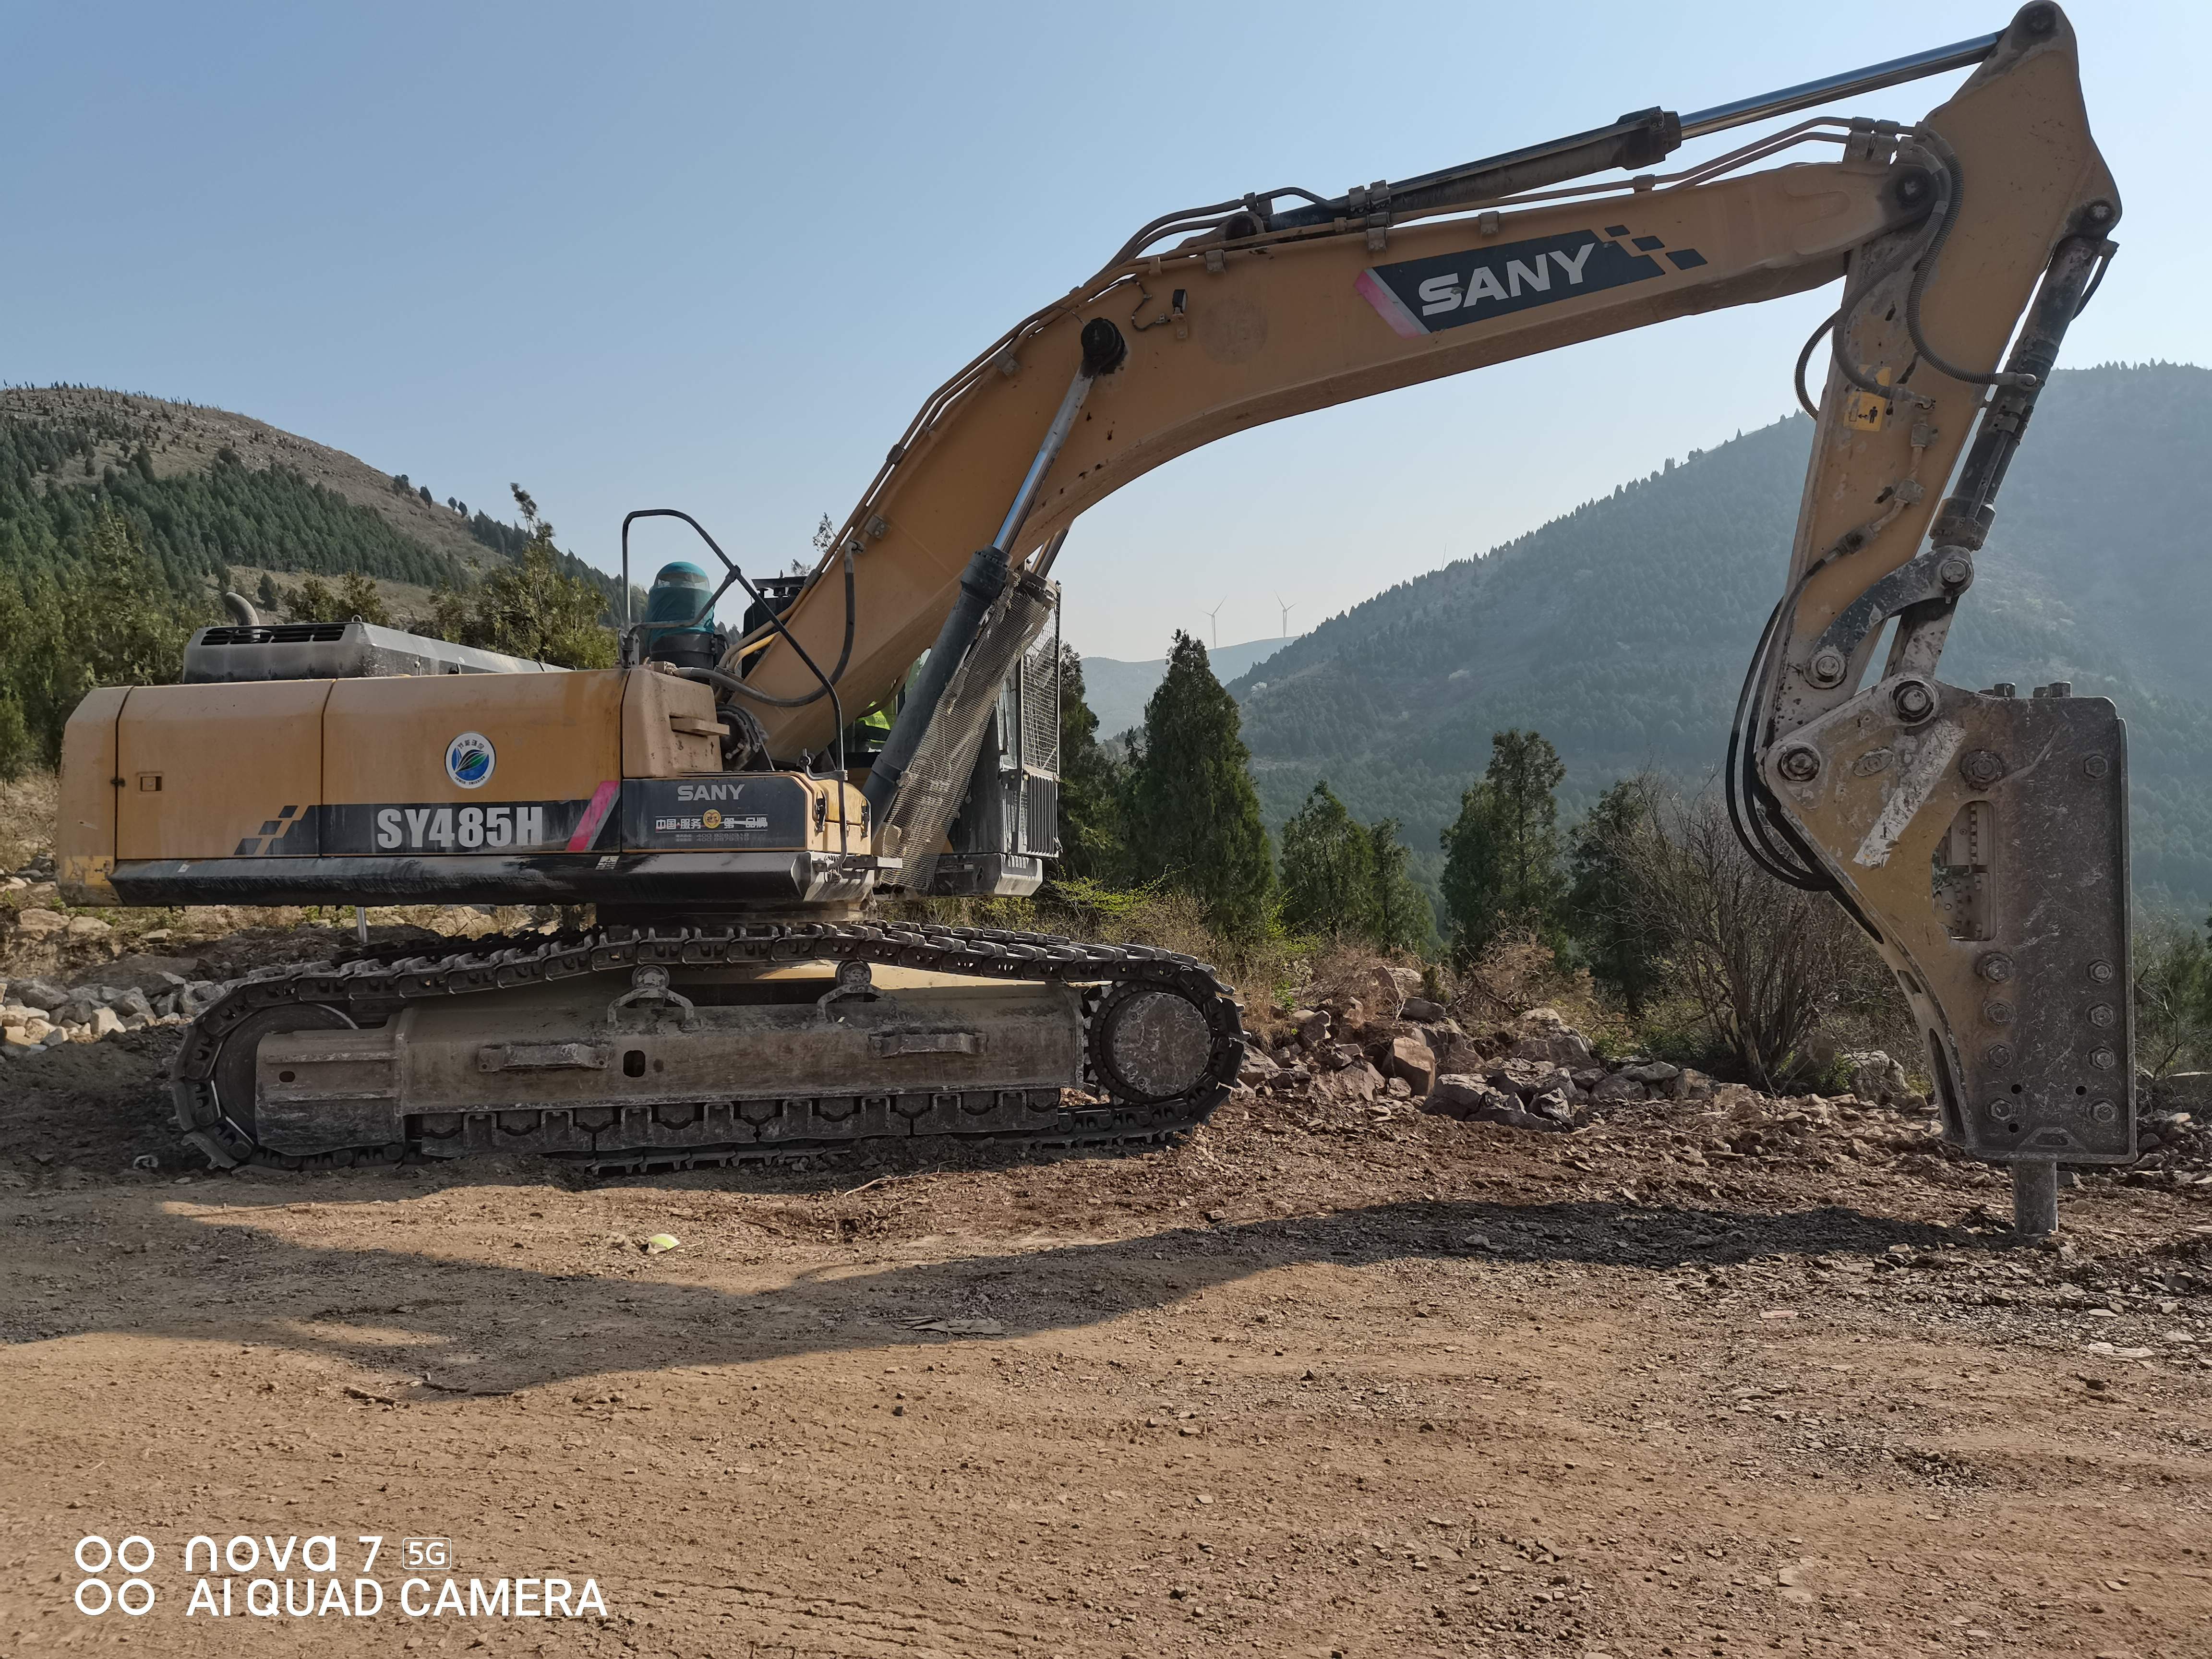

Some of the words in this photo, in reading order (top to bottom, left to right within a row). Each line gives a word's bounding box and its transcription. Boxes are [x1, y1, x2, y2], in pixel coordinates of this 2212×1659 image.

[1419, 242, 1596, 316] SANY
[677, 784, 745, 801] SANY
[377, 806, 543, 849] SY485H
